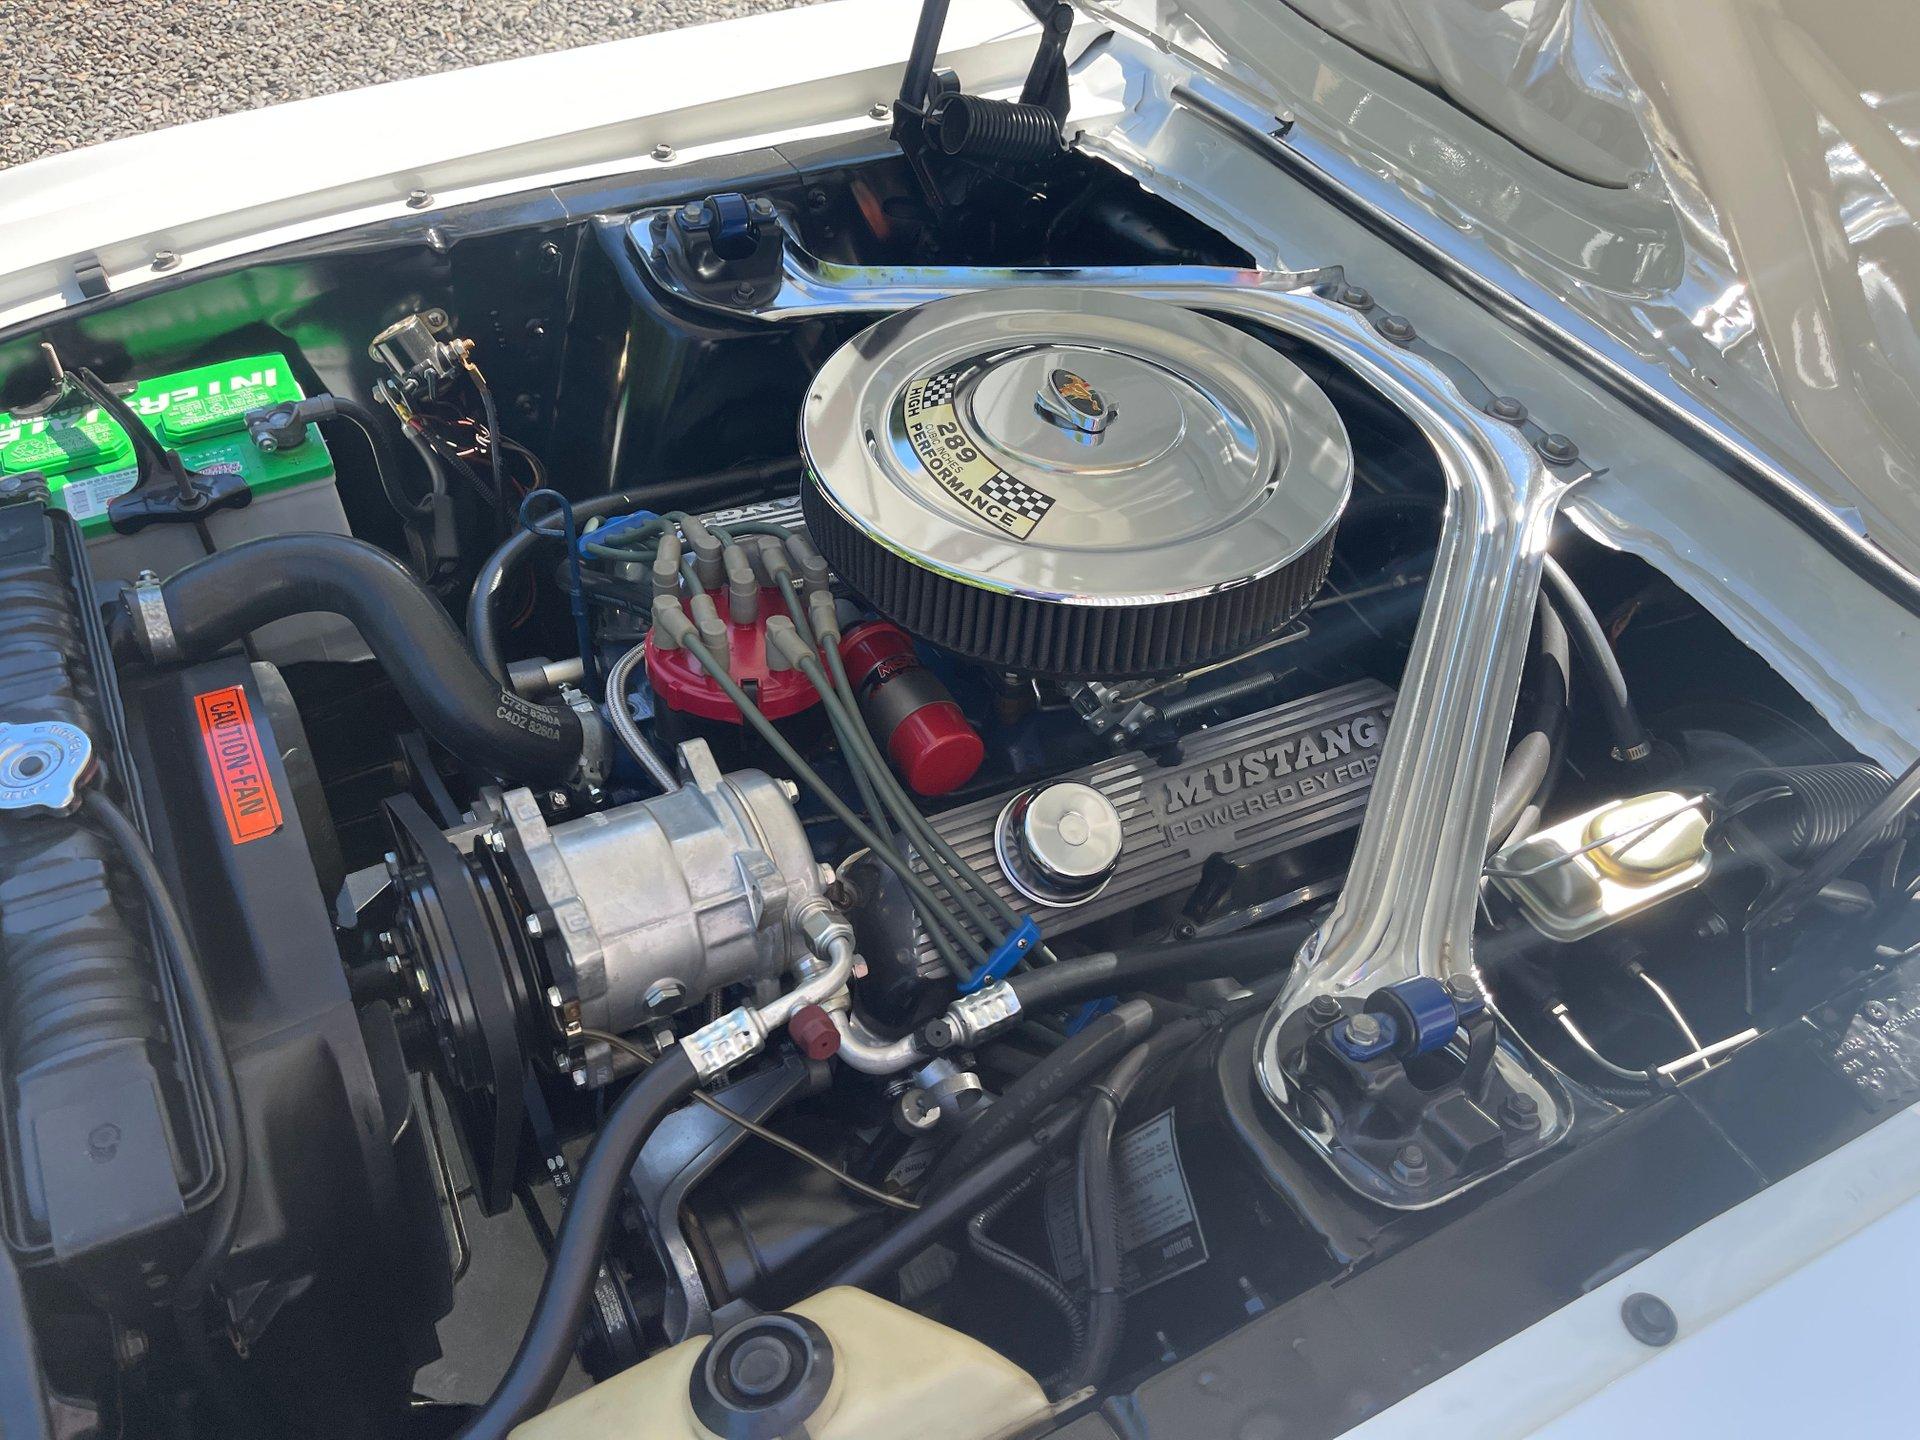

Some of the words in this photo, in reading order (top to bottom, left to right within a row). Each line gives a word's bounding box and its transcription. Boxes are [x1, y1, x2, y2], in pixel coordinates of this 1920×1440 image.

[907, 385, 923, 418] HIGH
[910, 422, 1017, 527] PERFORMANCE
[925, 423, 941, 447] CUBIC
[937, 446, 964, 474] INCHES
[936, 421, 978, 463] 289
[1165, 716, 1379, 813] MUSTANG
[1167, 784, 1297, 842] POWERED
[1300, 771, 1329, 795] BY
[1334, 754, 1380, 783] FOR
